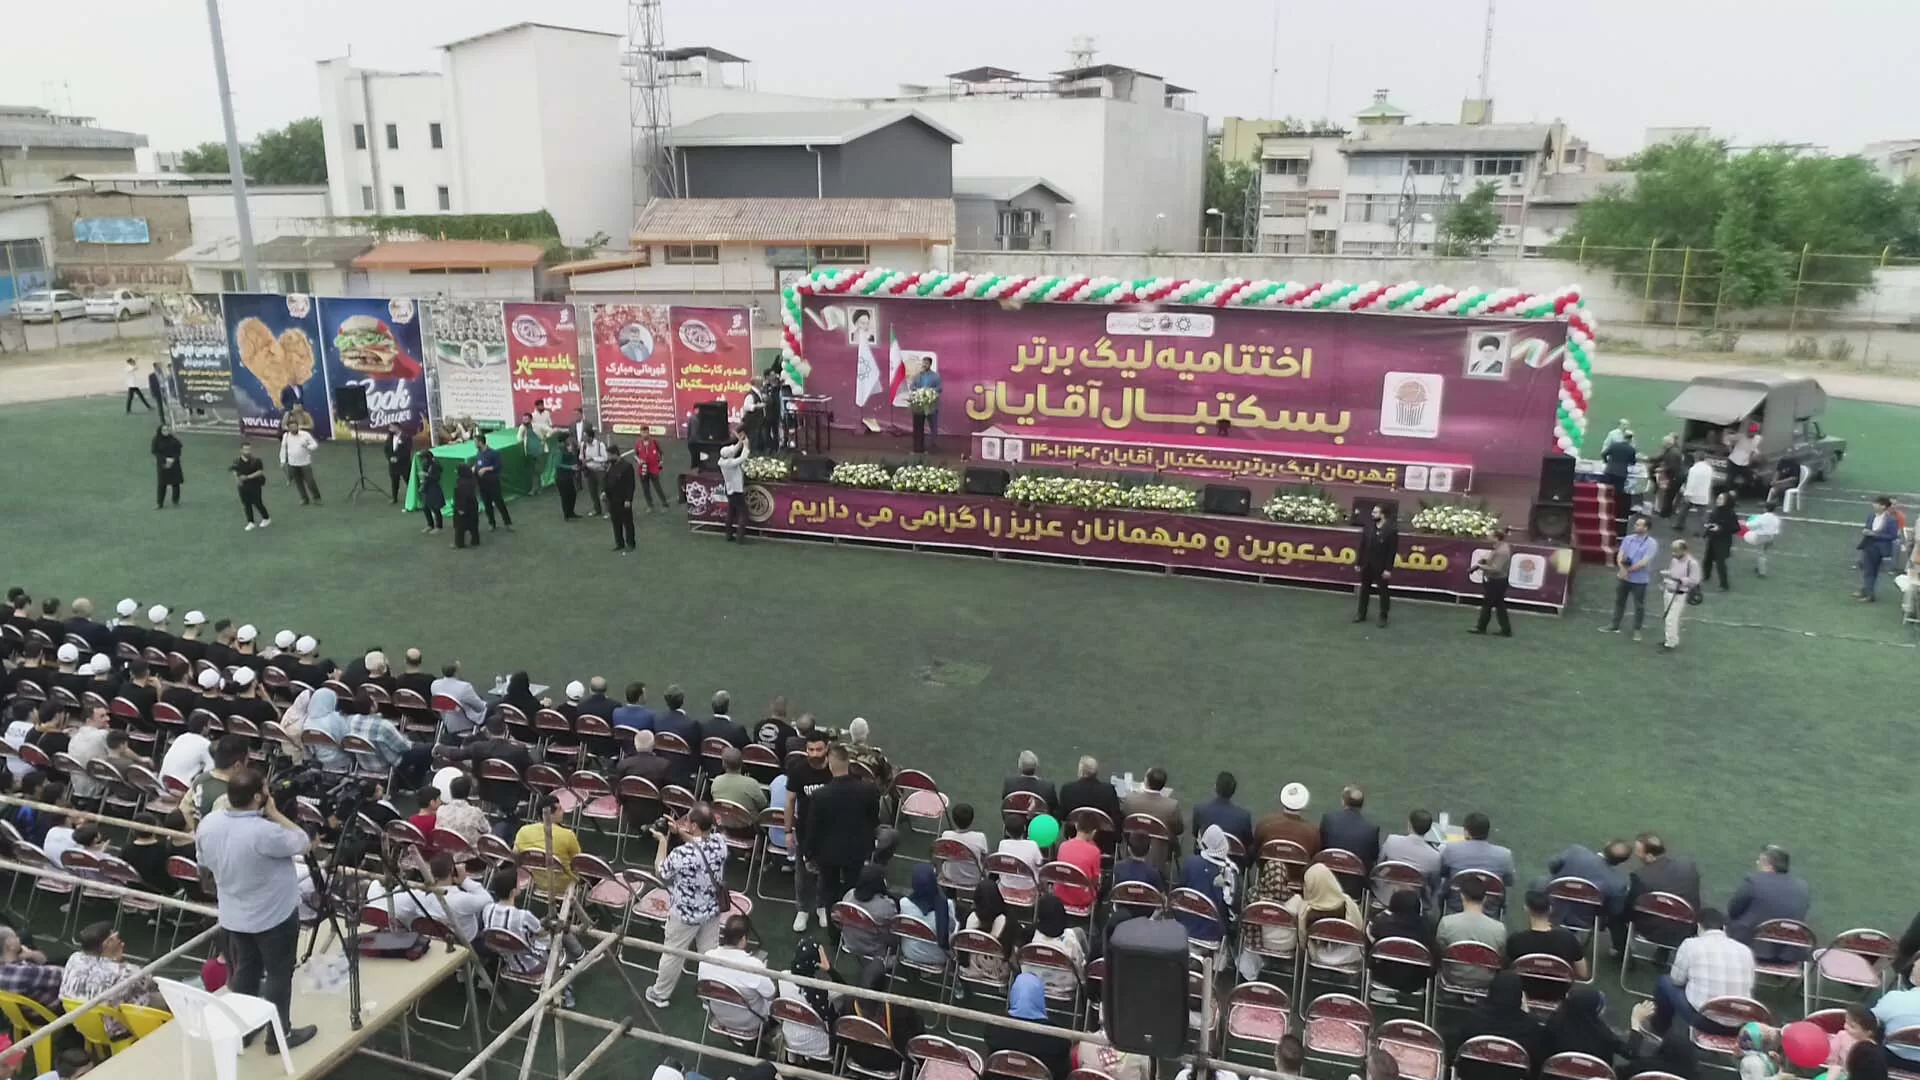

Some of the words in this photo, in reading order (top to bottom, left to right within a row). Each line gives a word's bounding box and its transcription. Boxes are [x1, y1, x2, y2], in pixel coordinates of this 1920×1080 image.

[605, 362, 633, 376] مبارک
[1010, 336, 1075, 375] برتر
[1079, 336, 1153, 378] لیگ
[1155, 343, 1313, 381] اختتامیه
[965, 380, 1103, 425] آقایان
[1101, 386, 1351, 445] بسکتبال
[1100, 447, 1154, 468] آقایان
[1155, 451, 1241, 475] بسکتبال
[1242, 457, 1278, 478] برتر
[1279, 459, 1320, 481] لیگ
[1321, 463, 1397, 484] قهرمان
[788, 496, 850, 525] داریم
[855, 505, 894, 528] می
[900, 504, 978, 533] گرامی
[983, 508, 1001, 538] را
[1005, 509, 1065, 542] عزیز
[1071, 517, 1207, 556] میهمانان
[1213, 534, 1231, 559] و
[1237, 534, 1357, 566] مدعوین
